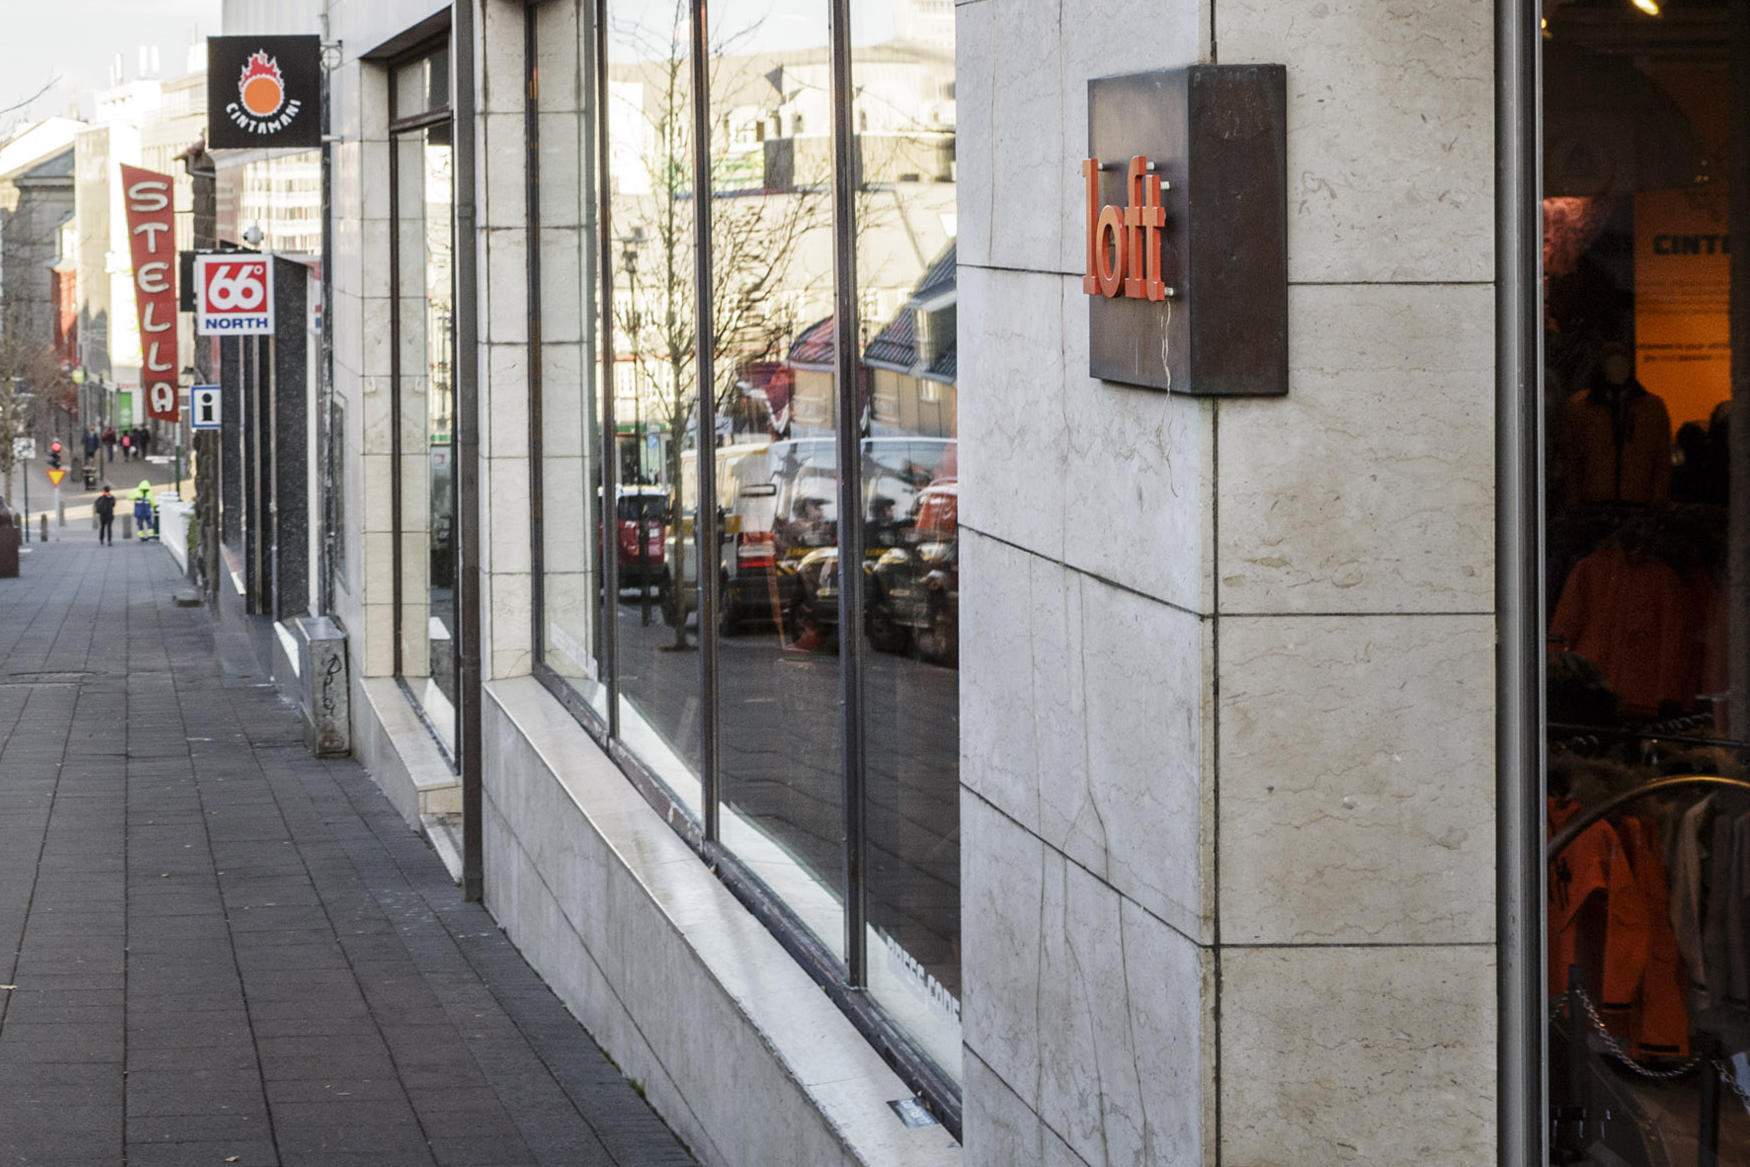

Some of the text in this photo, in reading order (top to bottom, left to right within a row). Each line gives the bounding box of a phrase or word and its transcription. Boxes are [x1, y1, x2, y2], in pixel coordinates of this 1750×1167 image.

[226, 99, 301, 134] CINTAMANI
[1082, 155, 1166, 302] loft
[128, 180, 174, 413] STELLA
[205, 316, 269, 330] NORTH
